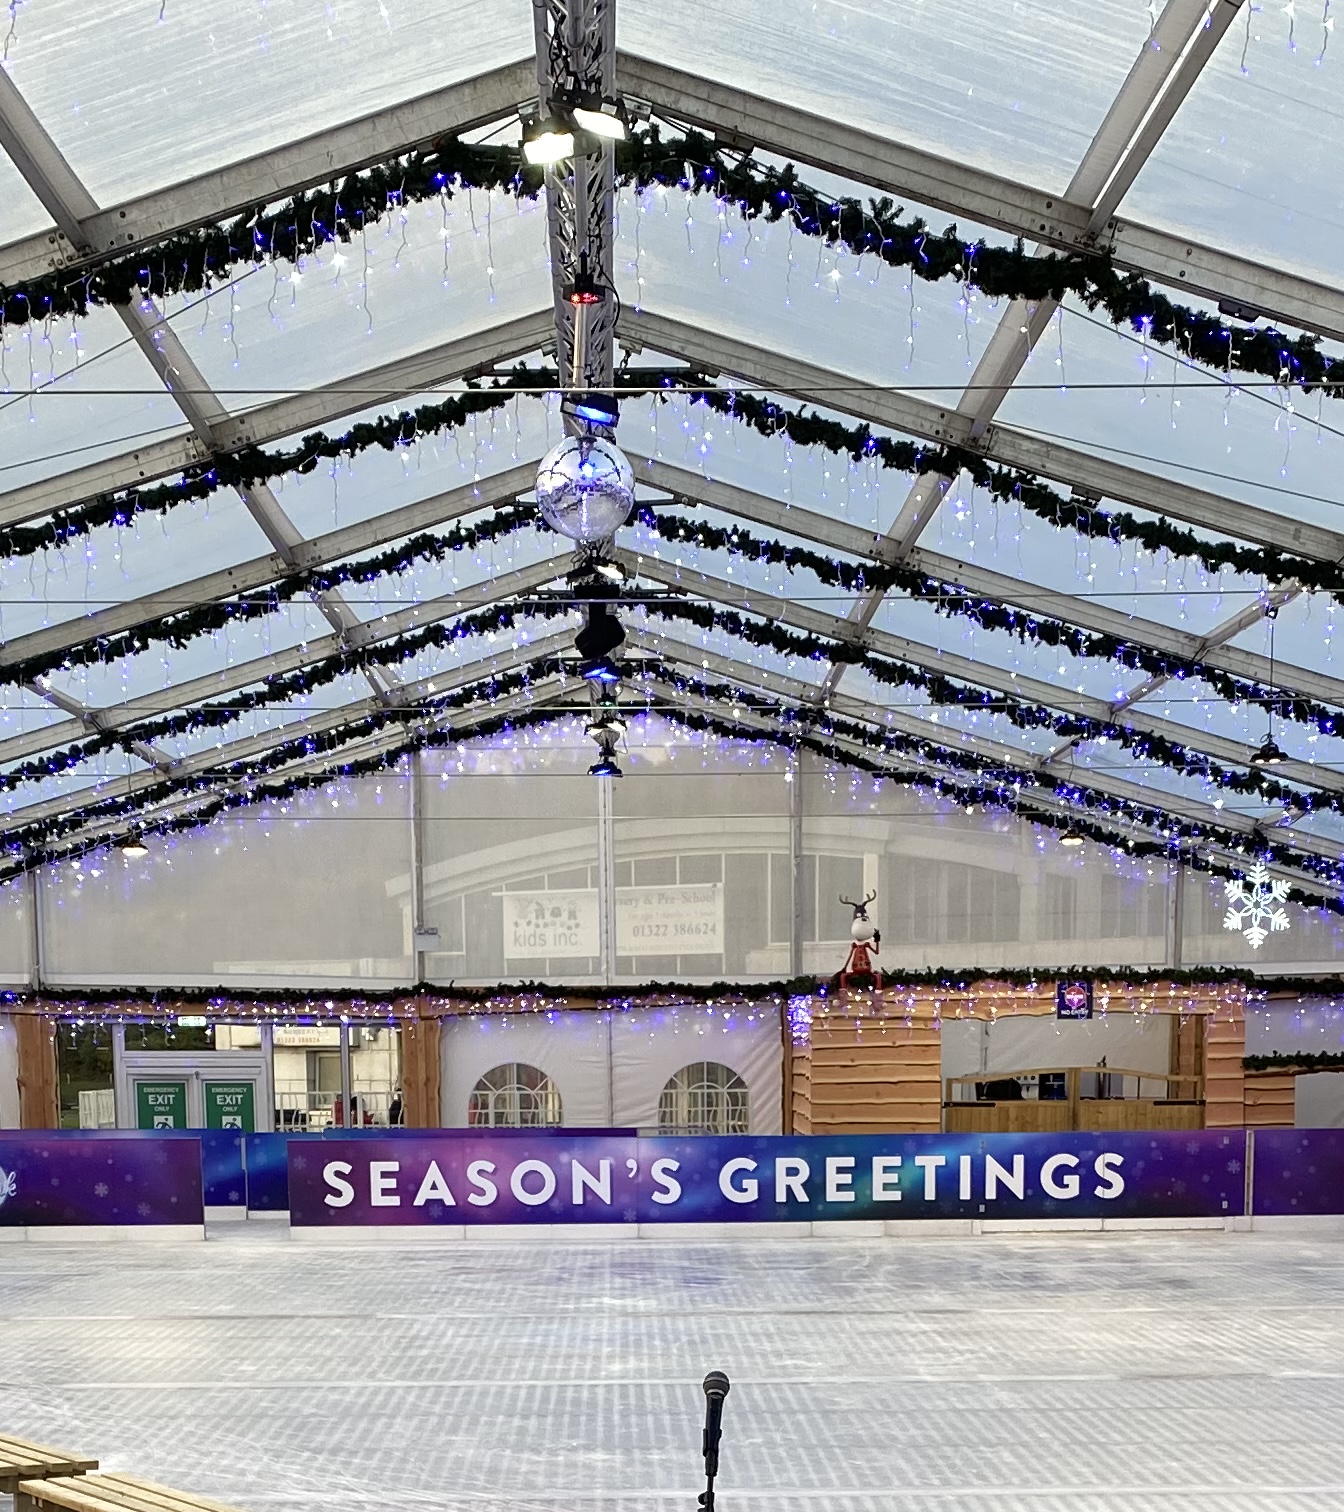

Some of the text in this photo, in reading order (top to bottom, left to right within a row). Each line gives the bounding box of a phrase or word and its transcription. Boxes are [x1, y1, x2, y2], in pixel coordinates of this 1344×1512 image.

[632, 921, 716, 938] 01322 386624
[513, 929, 547, 948] kids
[148, 1094, 175, 1105] EXIT
[216, 1094, 243, 1105] EXIT
[322, 1153, 1126, 1208] SEASON'S GREETINGS
